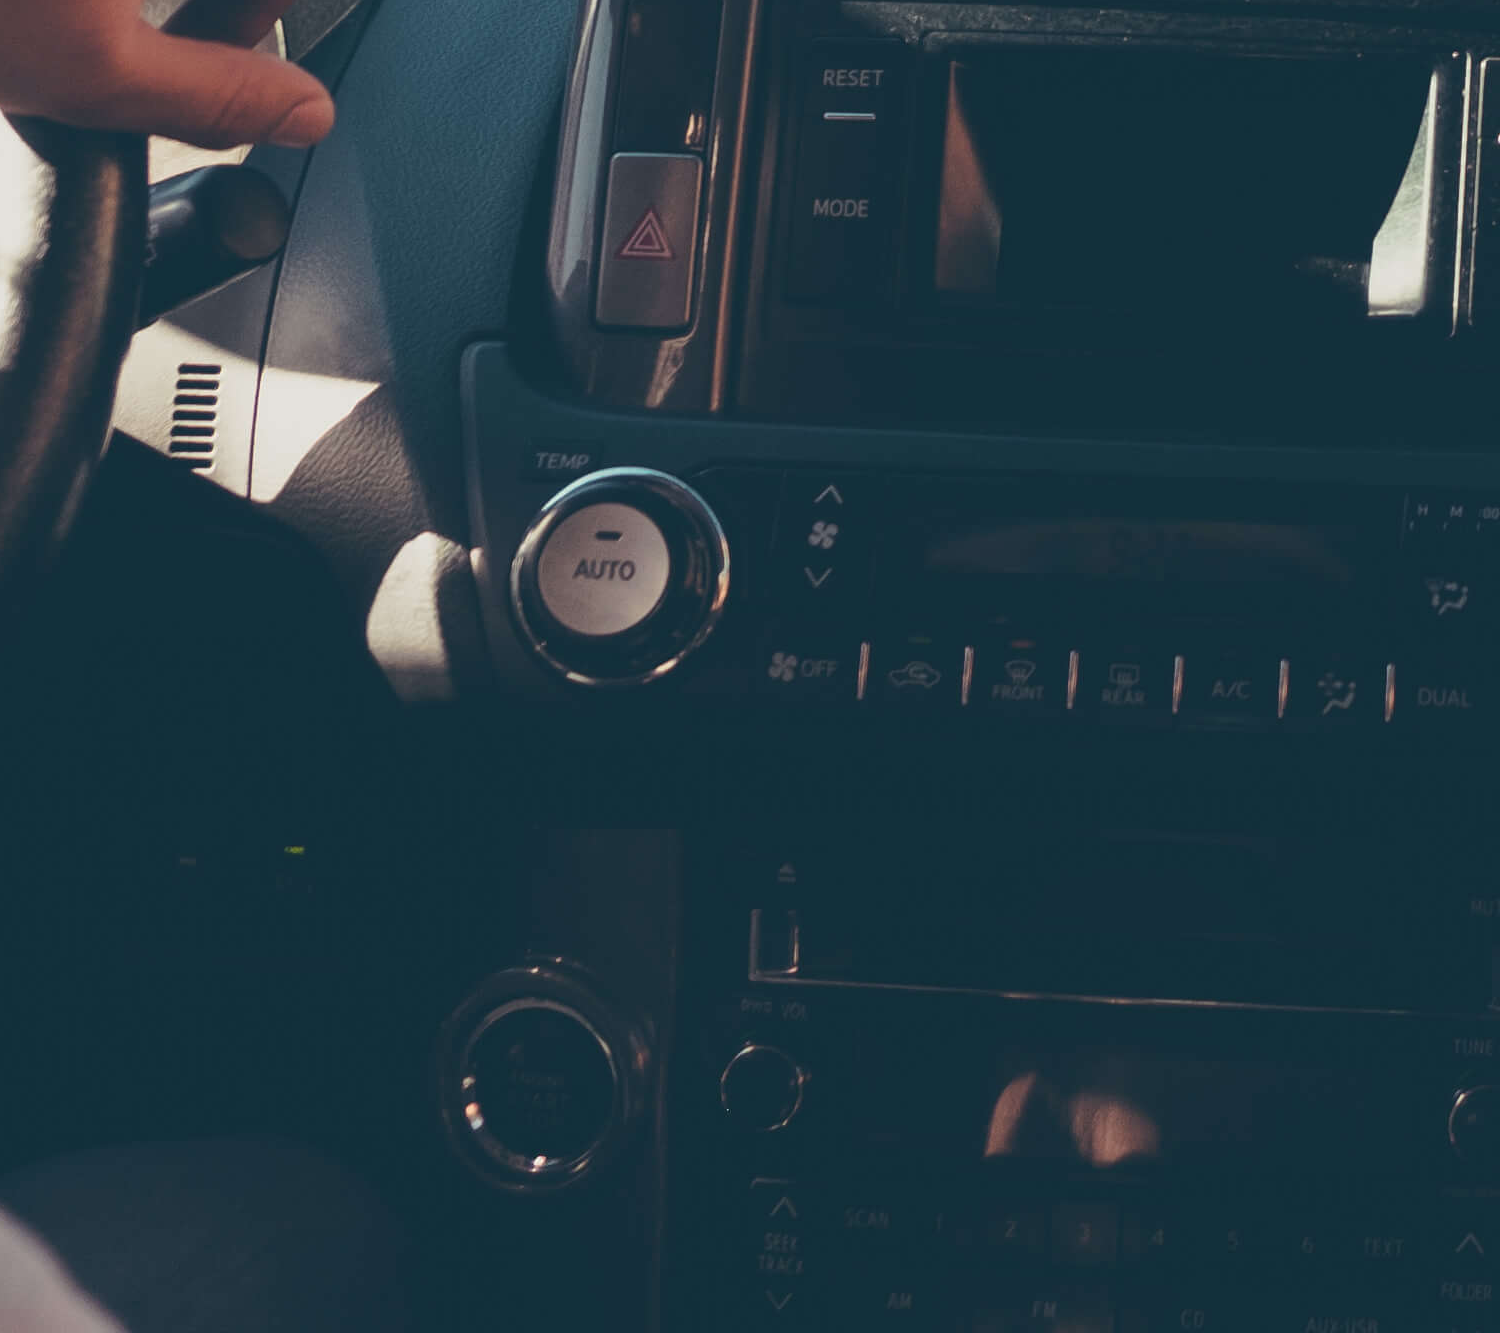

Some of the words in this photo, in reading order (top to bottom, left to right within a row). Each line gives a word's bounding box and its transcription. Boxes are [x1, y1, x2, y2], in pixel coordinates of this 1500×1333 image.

[822, 68, 884, 87] RESET
[812, 197, 869, 218] MODE
[535, 451, 590, 470] TEMP
[571, 557, 637, 582] AUTO
[800, 659, 839, 679] OFF
[991, 683, 1045, 701] FRONT
[1101, 688, 1147, 706] REAR
[1211, 680, 1252, 700] A/C
[1416, 686, 1473, 708] DUAL
[1004, 1220, 1019, 1238] 2
